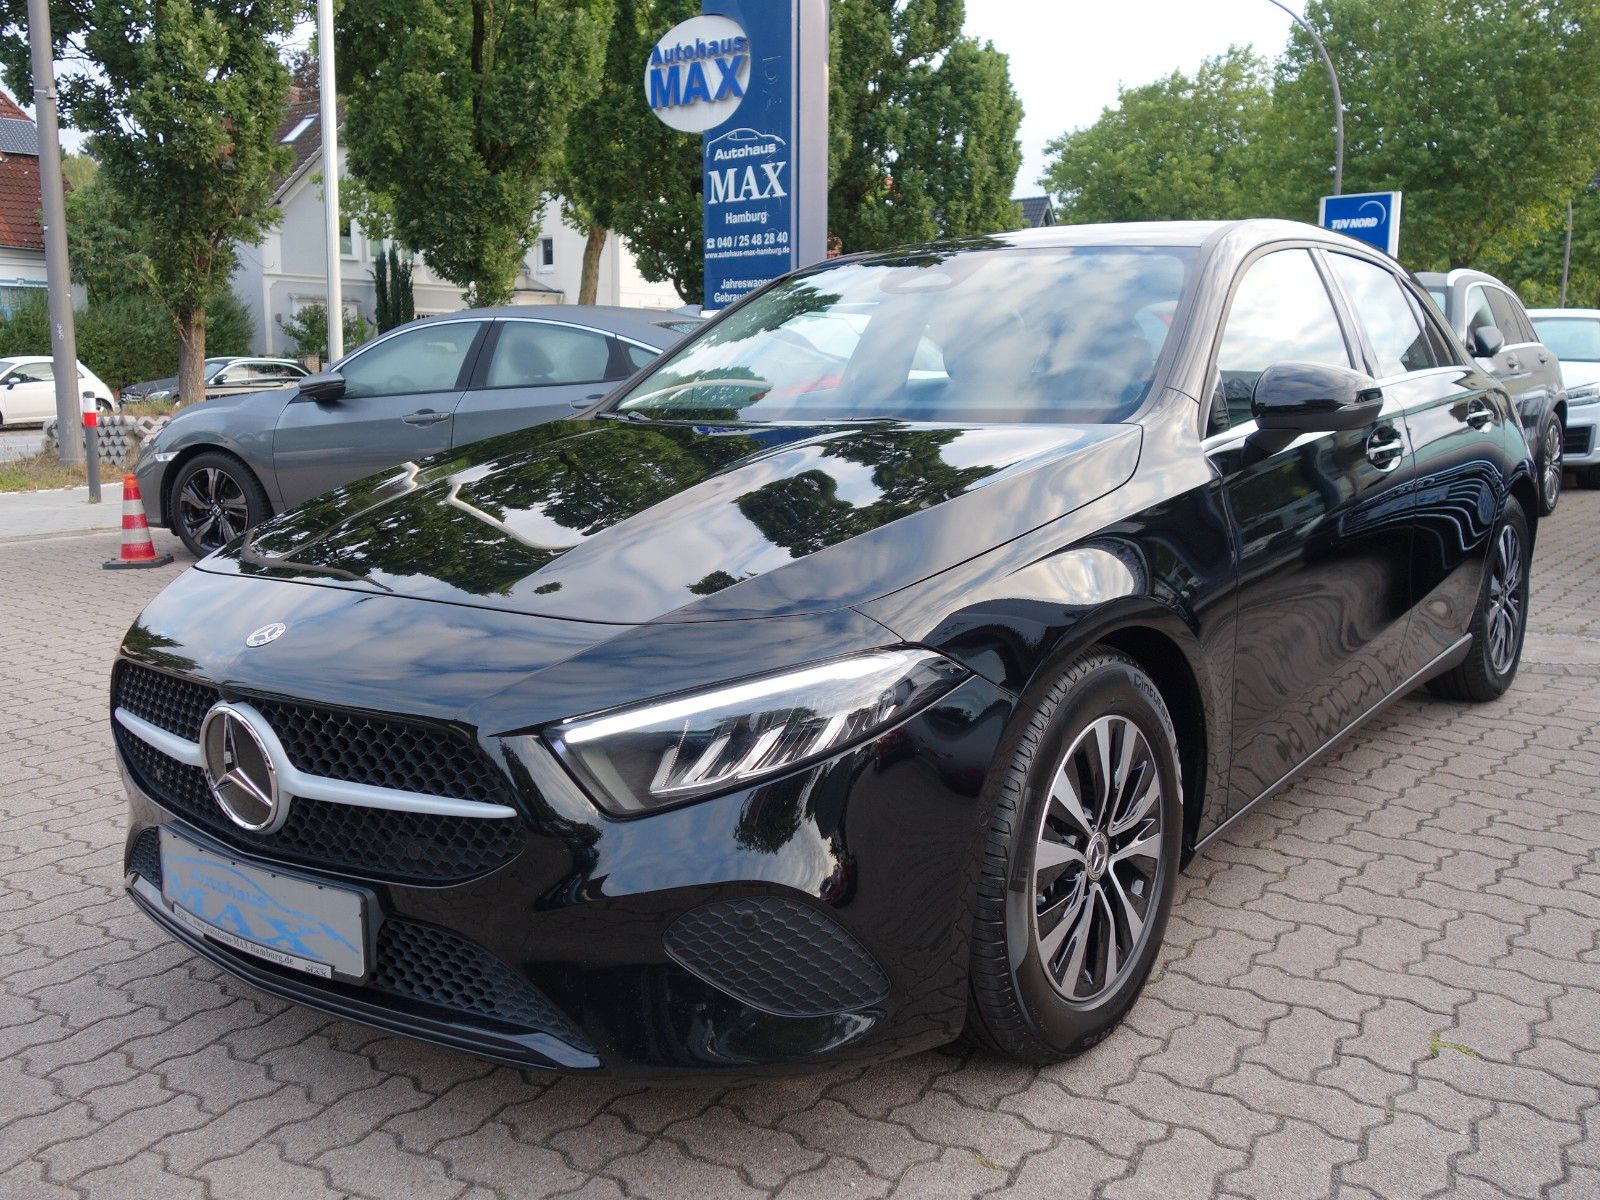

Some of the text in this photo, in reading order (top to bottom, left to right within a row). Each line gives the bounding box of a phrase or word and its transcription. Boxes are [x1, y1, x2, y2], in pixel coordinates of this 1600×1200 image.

[650, 36, 749, 65] Autohaus
[650, 54, 745, 109] MAX
[714, 143, 777, 161] Autohaus
[708, 161, 787, 204] MAX
[725, 210, 768, 224] Hamburg
[1350, 217, 1379, 229] NORD
[717, 235, 732, 248] 040
[739, 234, 750, 247] 25
[751, 233, 762, 245] 48
[764, 232, 775, 245] 28
[776, 231, 788, 243] 40
[705, 245, 790, 259] www.autohaus-max-hamburg.de
[165, 872, 326, 960] MAX
